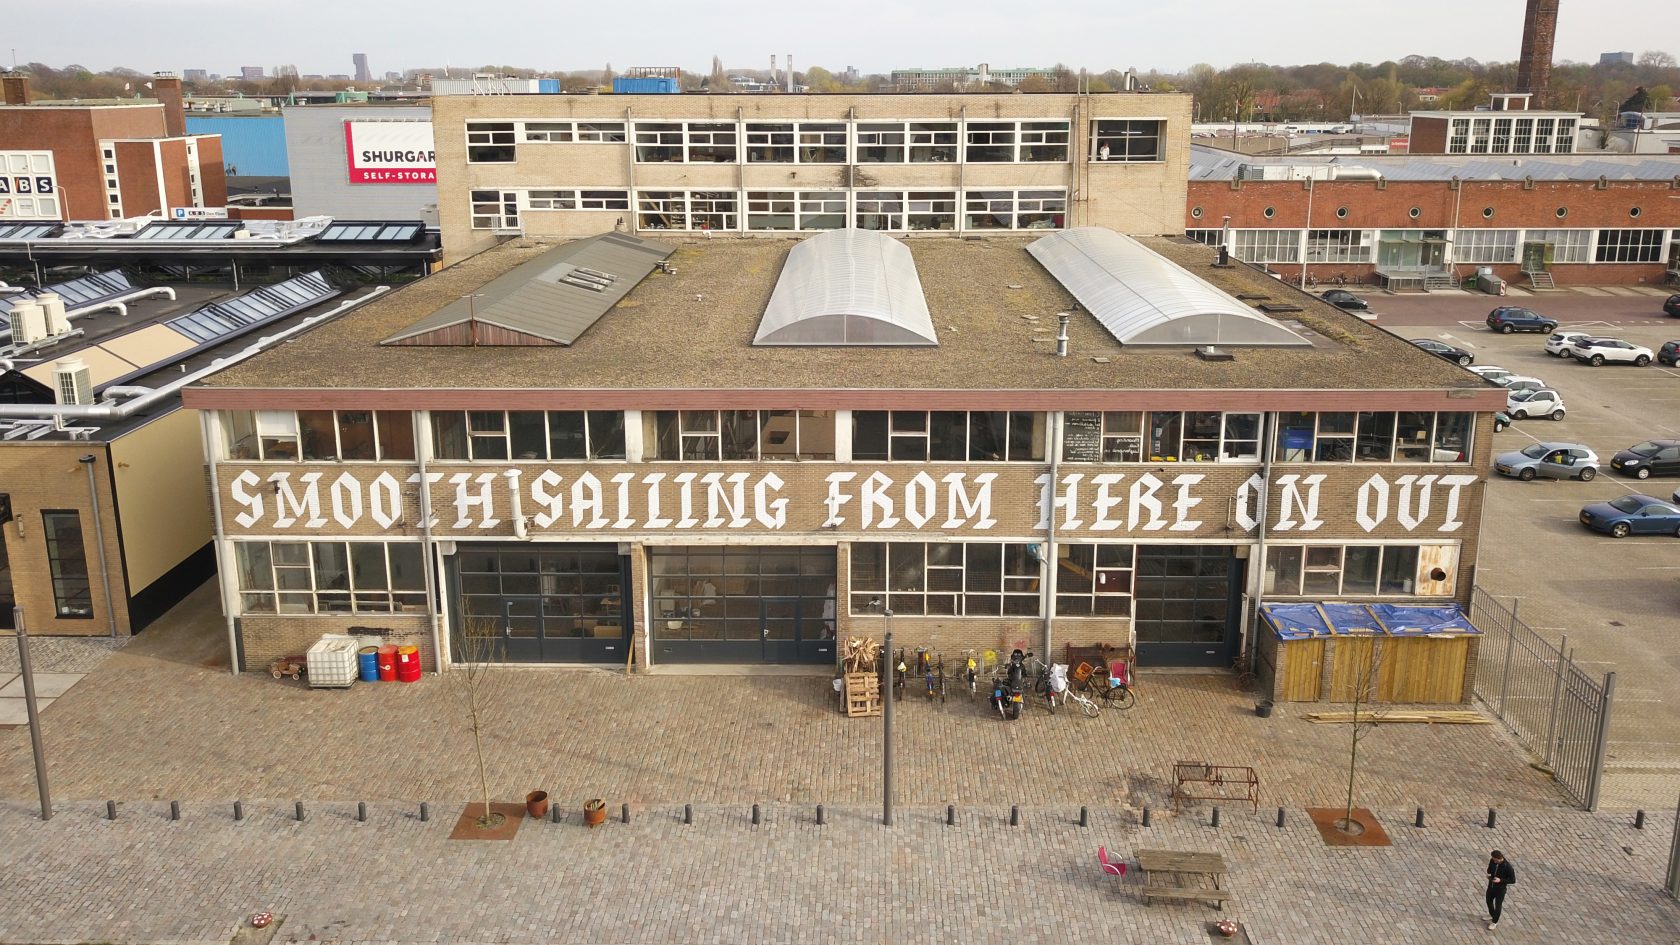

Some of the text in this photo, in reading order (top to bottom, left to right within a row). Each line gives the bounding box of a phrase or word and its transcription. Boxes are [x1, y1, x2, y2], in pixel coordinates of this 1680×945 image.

[362, 151, 435, 162] SHURGAR
[363, 172, 435, 180] SELF-STORA
[231, 469, 1479, 533] SMOOTH SAILING FROM HERE ON OUT
